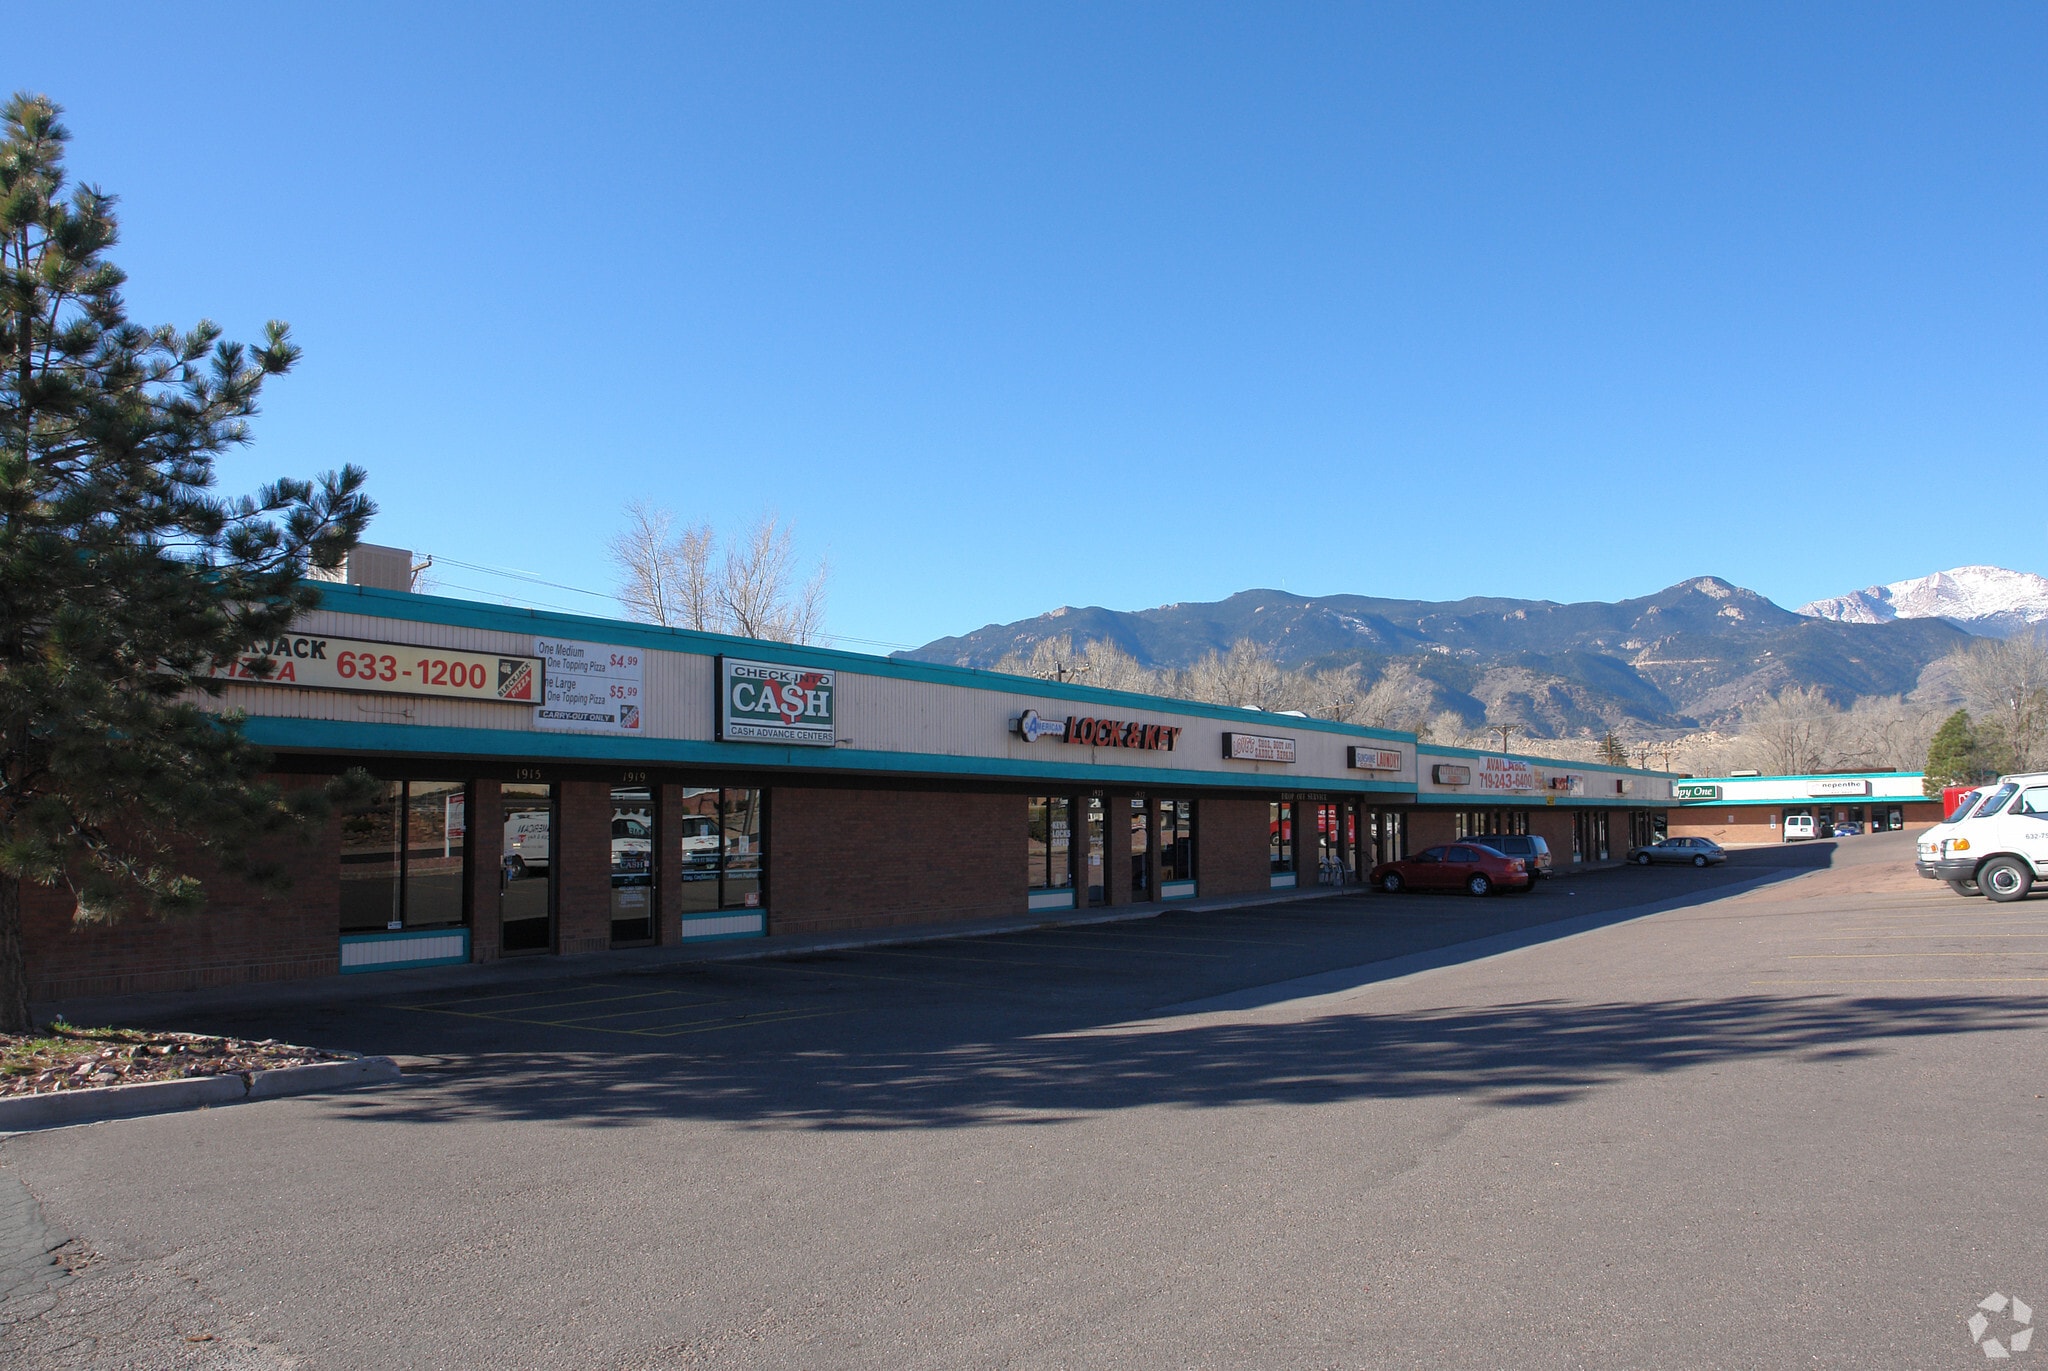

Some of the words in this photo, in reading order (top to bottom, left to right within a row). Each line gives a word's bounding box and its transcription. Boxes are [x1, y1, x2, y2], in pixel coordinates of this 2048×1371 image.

[241, 638, 327, 660] KJACK
[538, 641, 554, 655] One
[555, 643, 585, 658] Medium
[547, 656, 561, 668] One
[562, 658, 588, 673] Topping
[589, 660, 606, 673] Pizza
[609, 653, 638, 669] $4.99
[336, 651, 487, 689] 633-1200
[734, 666, 791, 681] CHECK
[793, 673, 830, 685] INTO
[497, 661, 531, 698] BLACKJACK
[511, 675, 531, 698] PIZZA
[555, 676, 577, 692] Large
[547, 690, 561, 702] One
[562, 691, 588, 706] Topping
[588, 693, 606, 705] Pizza
[609, 684, 638, 700] $5.99
[542, 710, 588, 720] CARRY-OUT
[589, 713, 610, 722] ONLY
[731, 726, 755, 736] CASH
[756, 728, 795, 739] ADVANCE
[796, 731, 834, 741] CENTERS
[1066, 716, 1125, 747] LOCK
[1126, 721, 1141, 749] &
[1142, 724, 1183, 751] KEY
[1376, 751, 1400, 769] LAUNDRY
[1486, 757, 1527, 772] AVAILABLE
[516, 768, 542, 780] 1915
[623, 771, 646, 783] 1919
[1693, 786, 1713, 796] One
[1051, 829, 1071, 838] LOCKS
